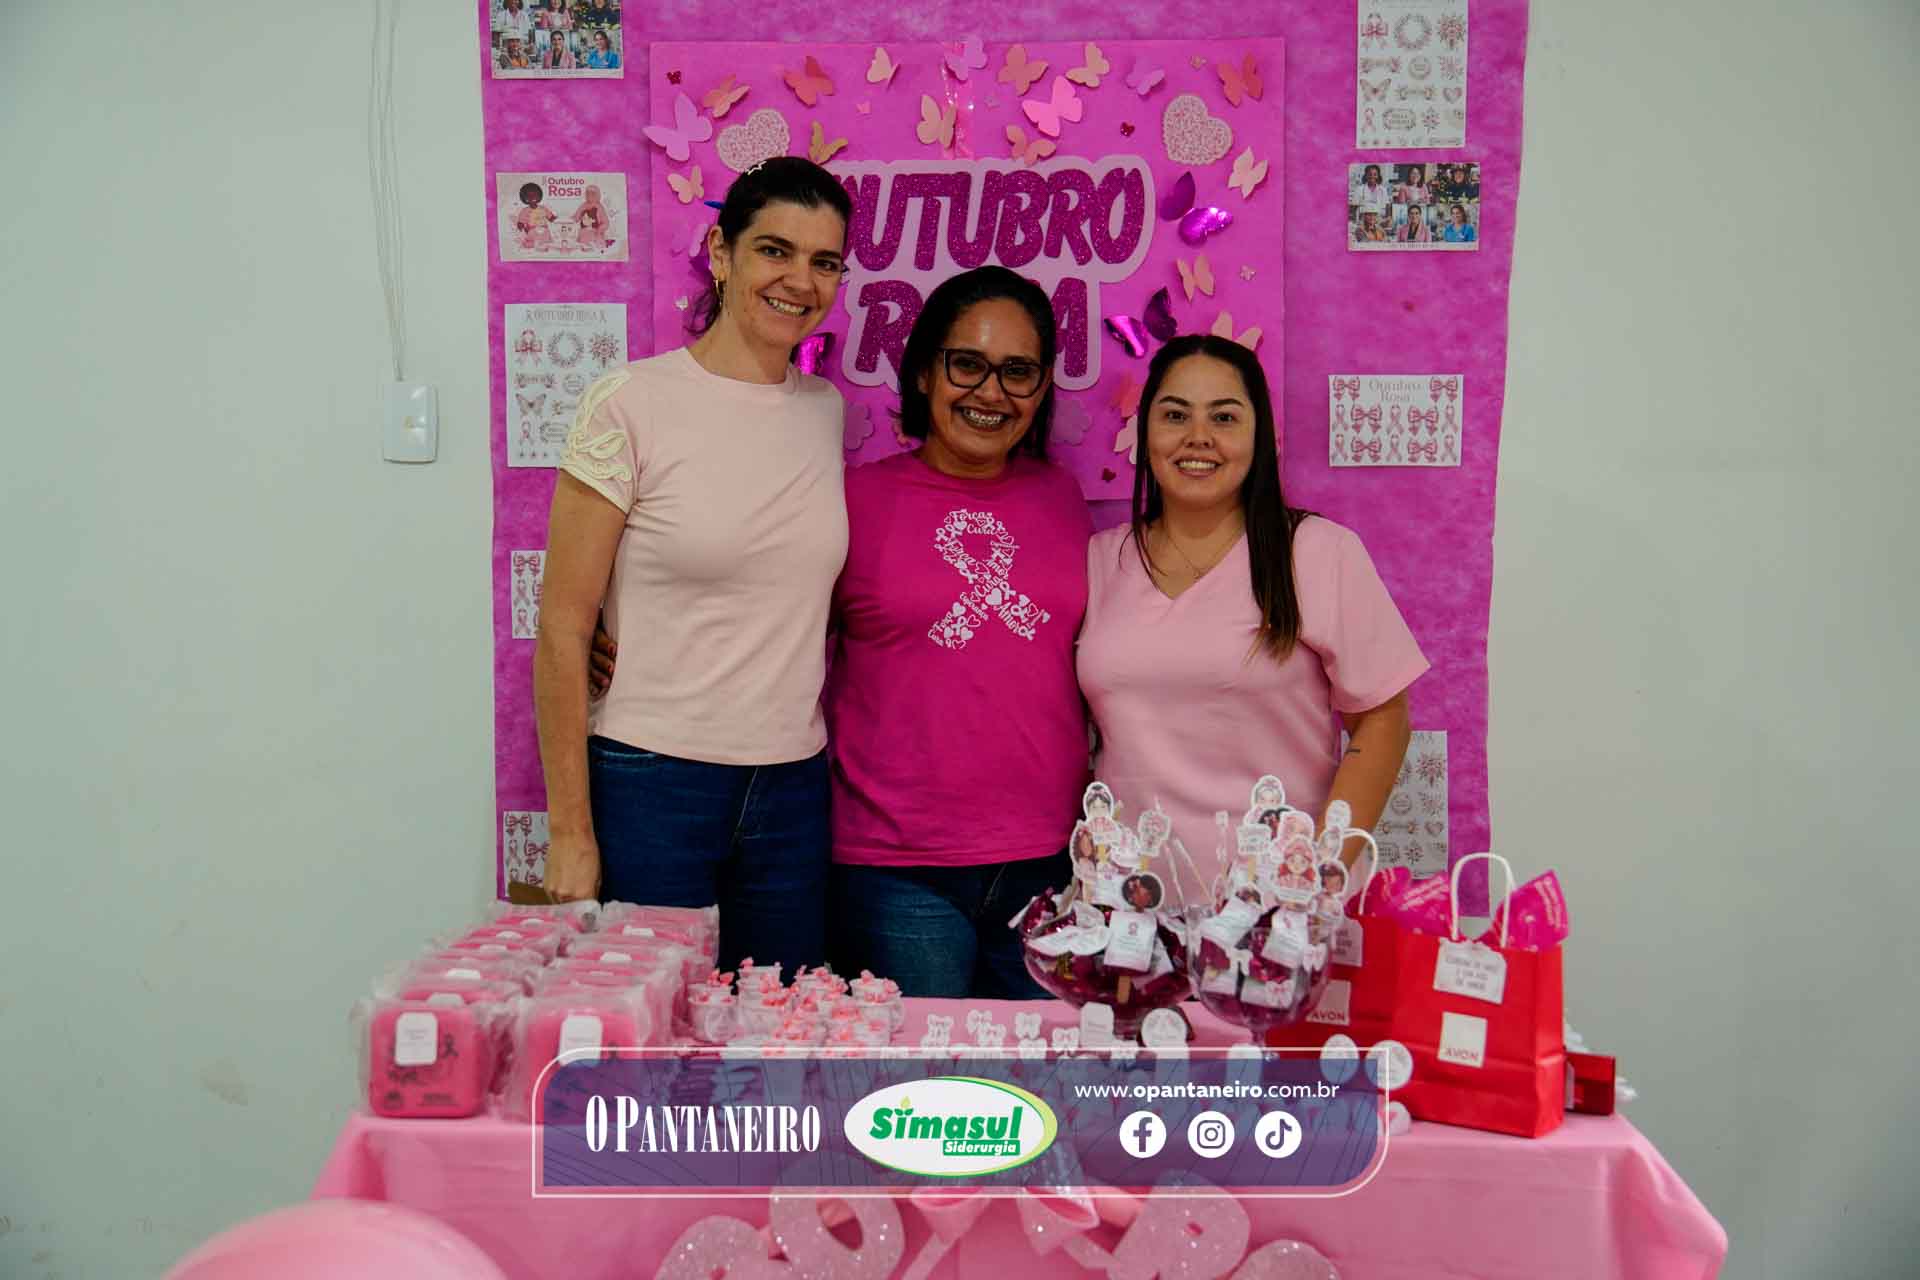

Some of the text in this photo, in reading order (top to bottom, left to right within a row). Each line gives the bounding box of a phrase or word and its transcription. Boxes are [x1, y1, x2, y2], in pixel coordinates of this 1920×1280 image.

[547, 176, 585, 185] Outubro
[548, 185, 582, 197] Rosa
[834, 167, 1145, 271] UTUBRO
[855, 277, 1088, 378] RA
[1309, 1010, 1346, 1022] AVON
[1443, 1047, 1480, 1062] AVON
